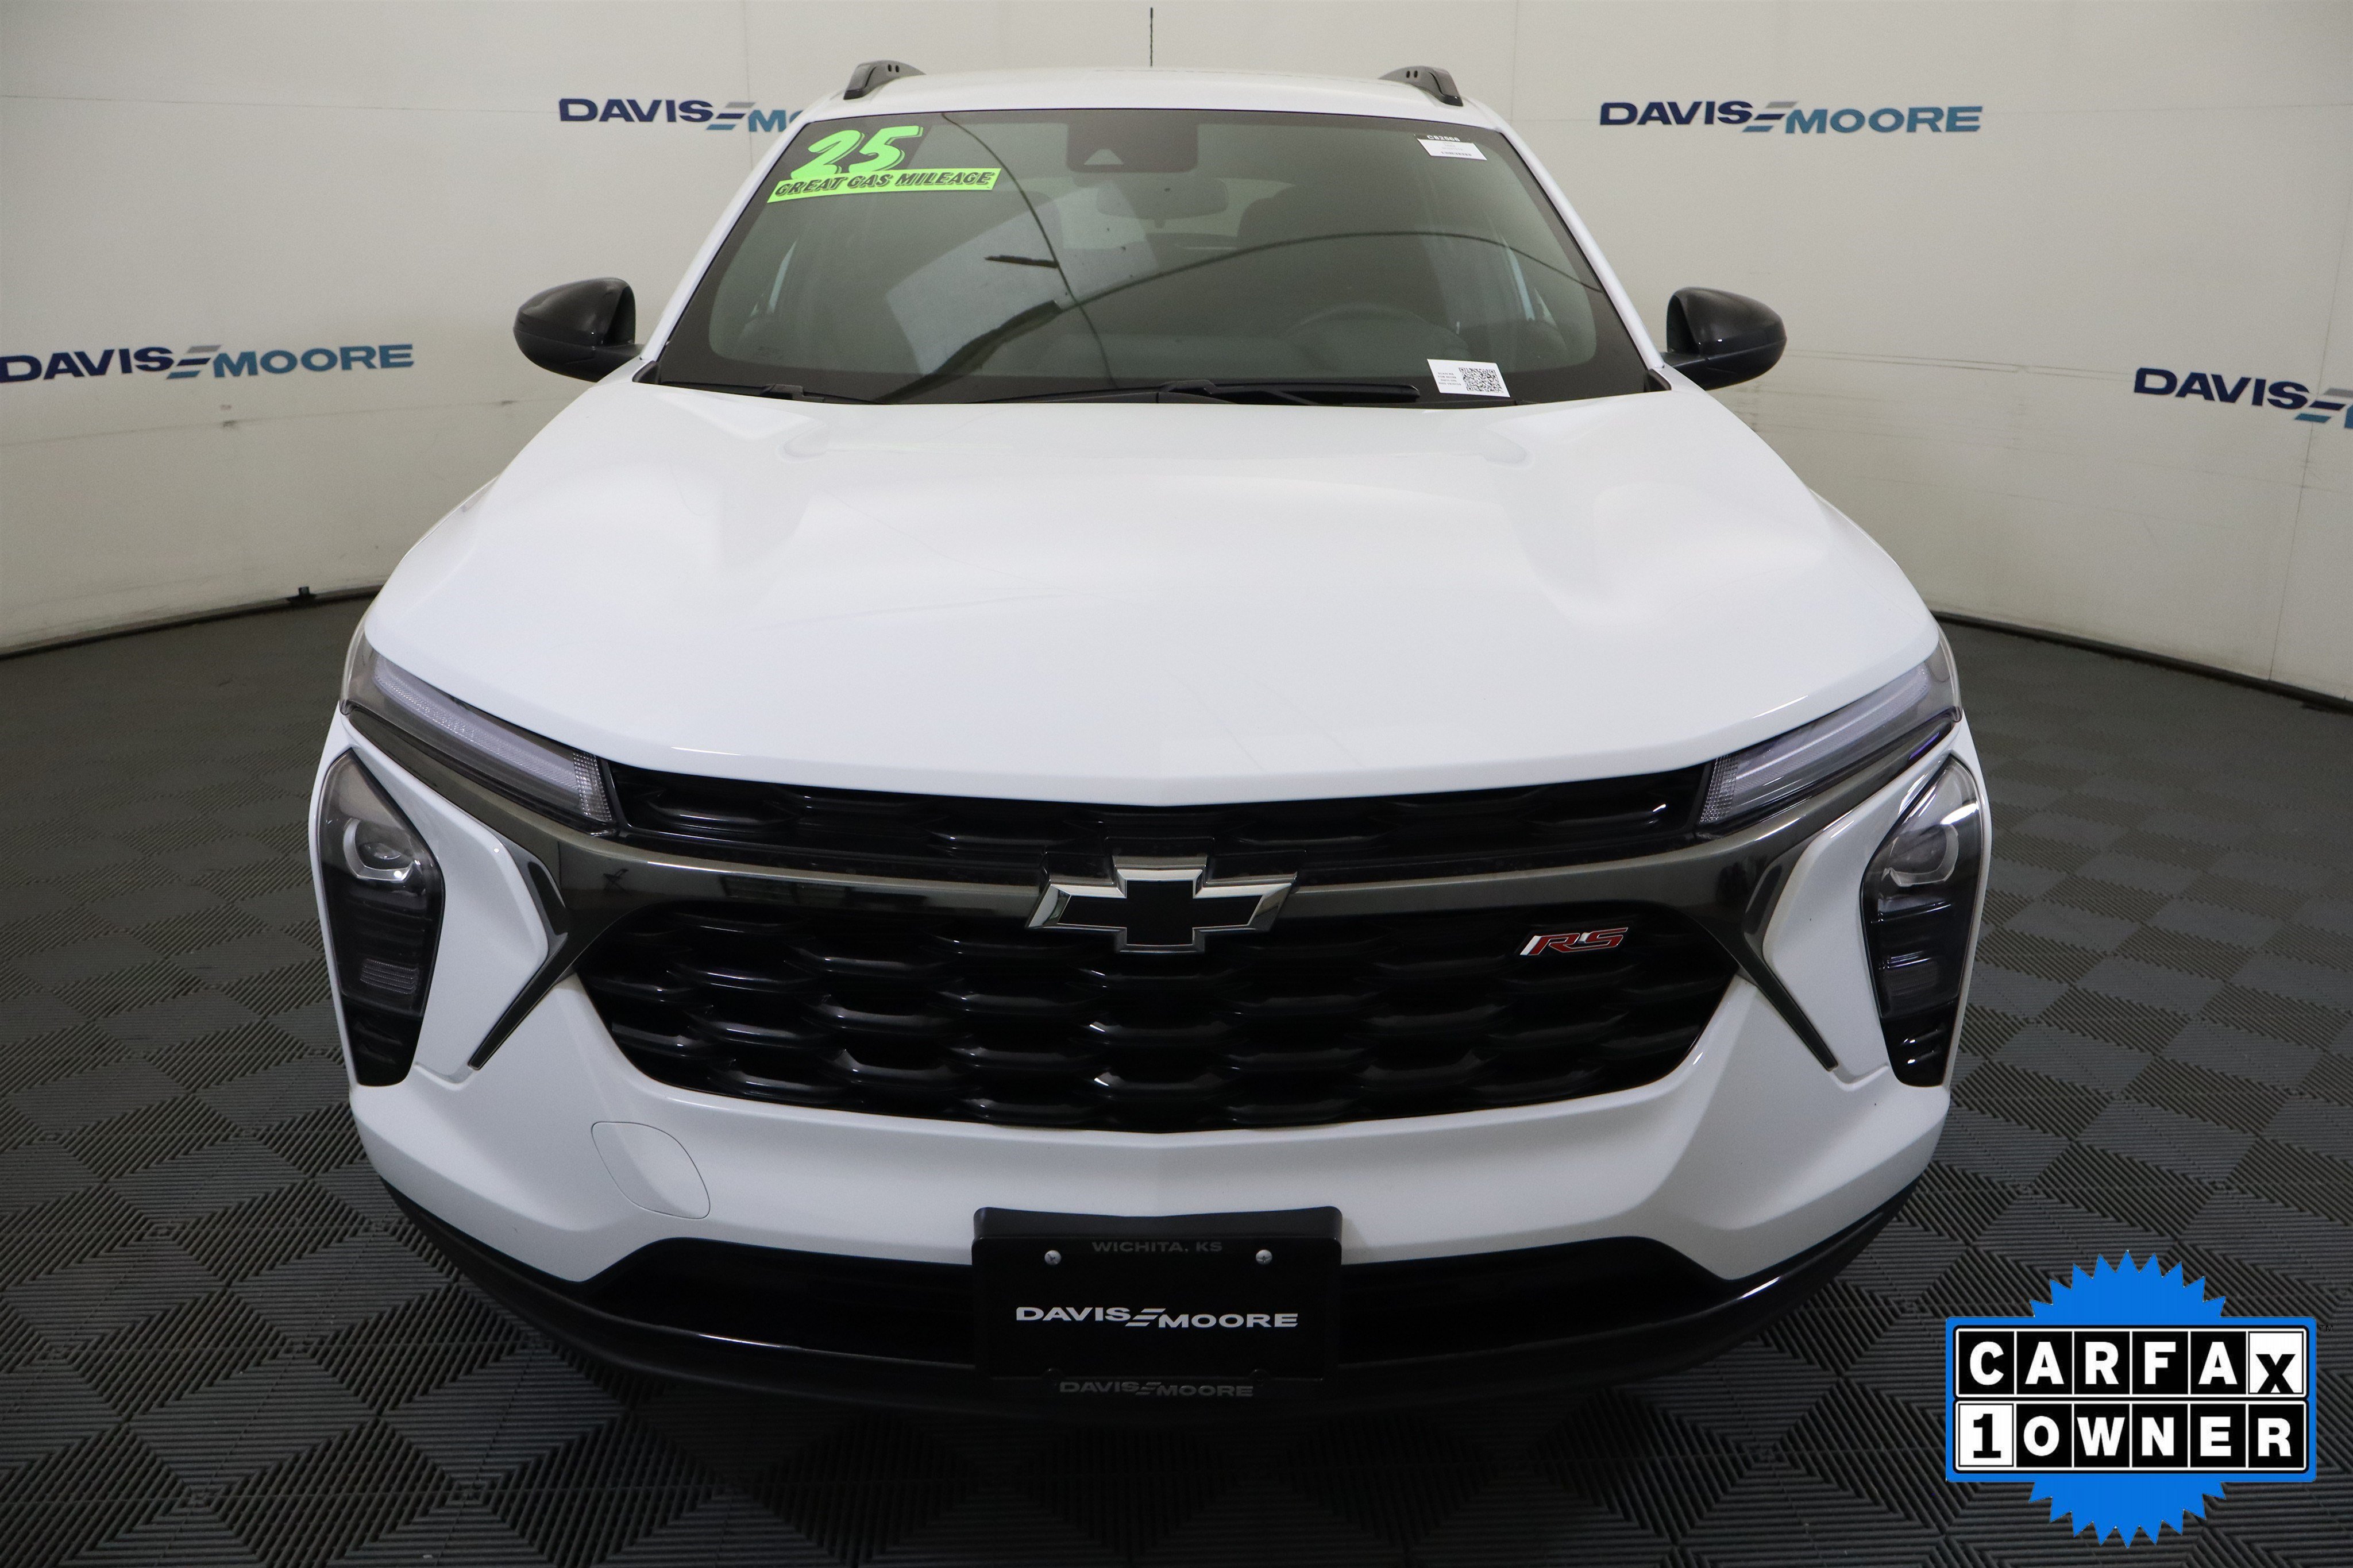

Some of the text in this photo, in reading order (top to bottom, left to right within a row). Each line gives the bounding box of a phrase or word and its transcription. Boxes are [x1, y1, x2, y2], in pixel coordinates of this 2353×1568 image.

[558, 98, 714, 123] DAVIS
[1599, 100, 1984, 134] DAVIS MOORE
[790, 125, 924, 179] 25
[774, 171, 995, 196] GREAT GAS MILEAGE
[0, 343, 415, 384] DAVIS MOORE
[2133, 367, 2310, 411] DAVIS
[1519, 926, 1629, 956] RS
[1195, 1241, 1223, 1253] KS
[1016, 1307, 1298, 1328] DAVIS MOORE
[1059, 1381, 1253, 1397] DAVIS MOORE
